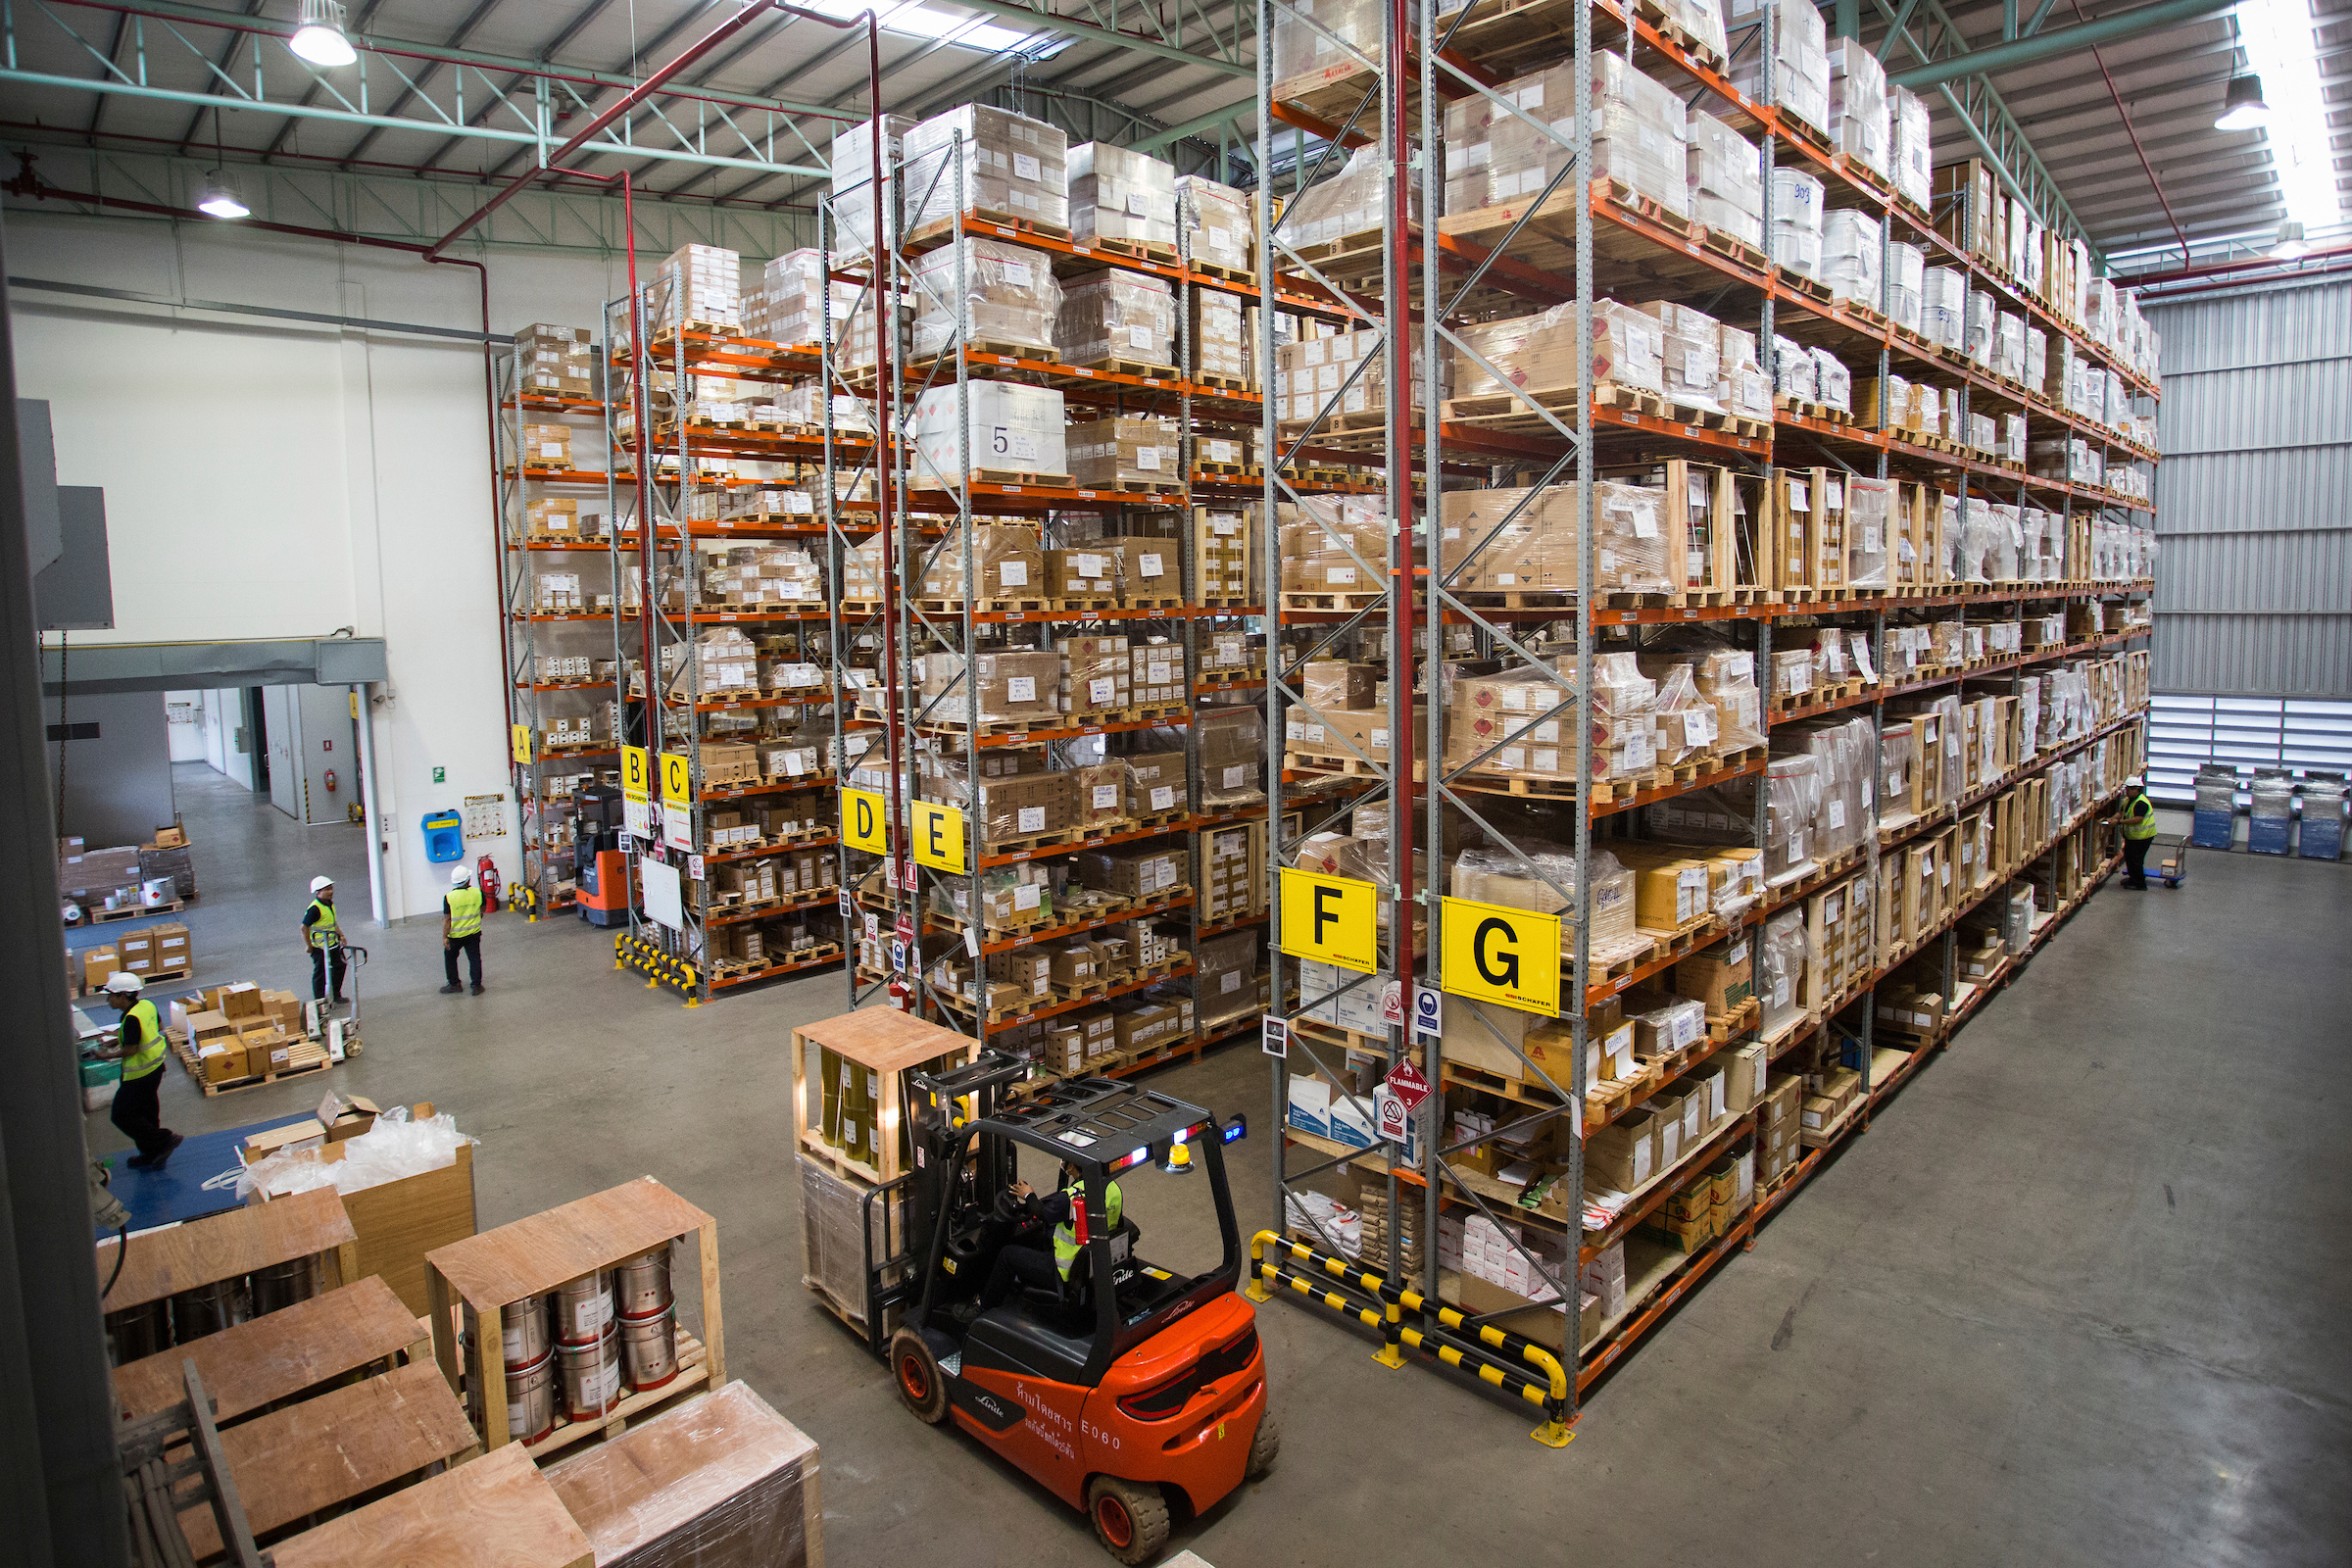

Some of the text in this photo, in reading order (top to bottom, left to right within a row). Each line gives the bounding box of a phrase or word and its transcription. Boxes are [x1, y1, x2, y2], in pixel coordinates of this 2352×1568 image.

[1787, 72, 1795, 103] 4
[1793, 183, 1811, 204] 903
[993, 426, 1008, 454] 5
[517, 735, 526, 757] A
[630, 753, 640, 783] B
[669, 760, 680, 793] C
[857, 798, 873, 839] D
[929, 811, 946, 858] E
[1314, 885, 1343, 945] F
[1473, 917, 1519, 990] G
[1389, 1076, 1429, 1093] FLAMMABLE
[1406, 1098, 1412, 1106] 3
[1160, 1299, 1196, 1324] Linde
[974, 1395, 1005, 1418] Linde
[1081, 1419, 1120, 1449] E060
